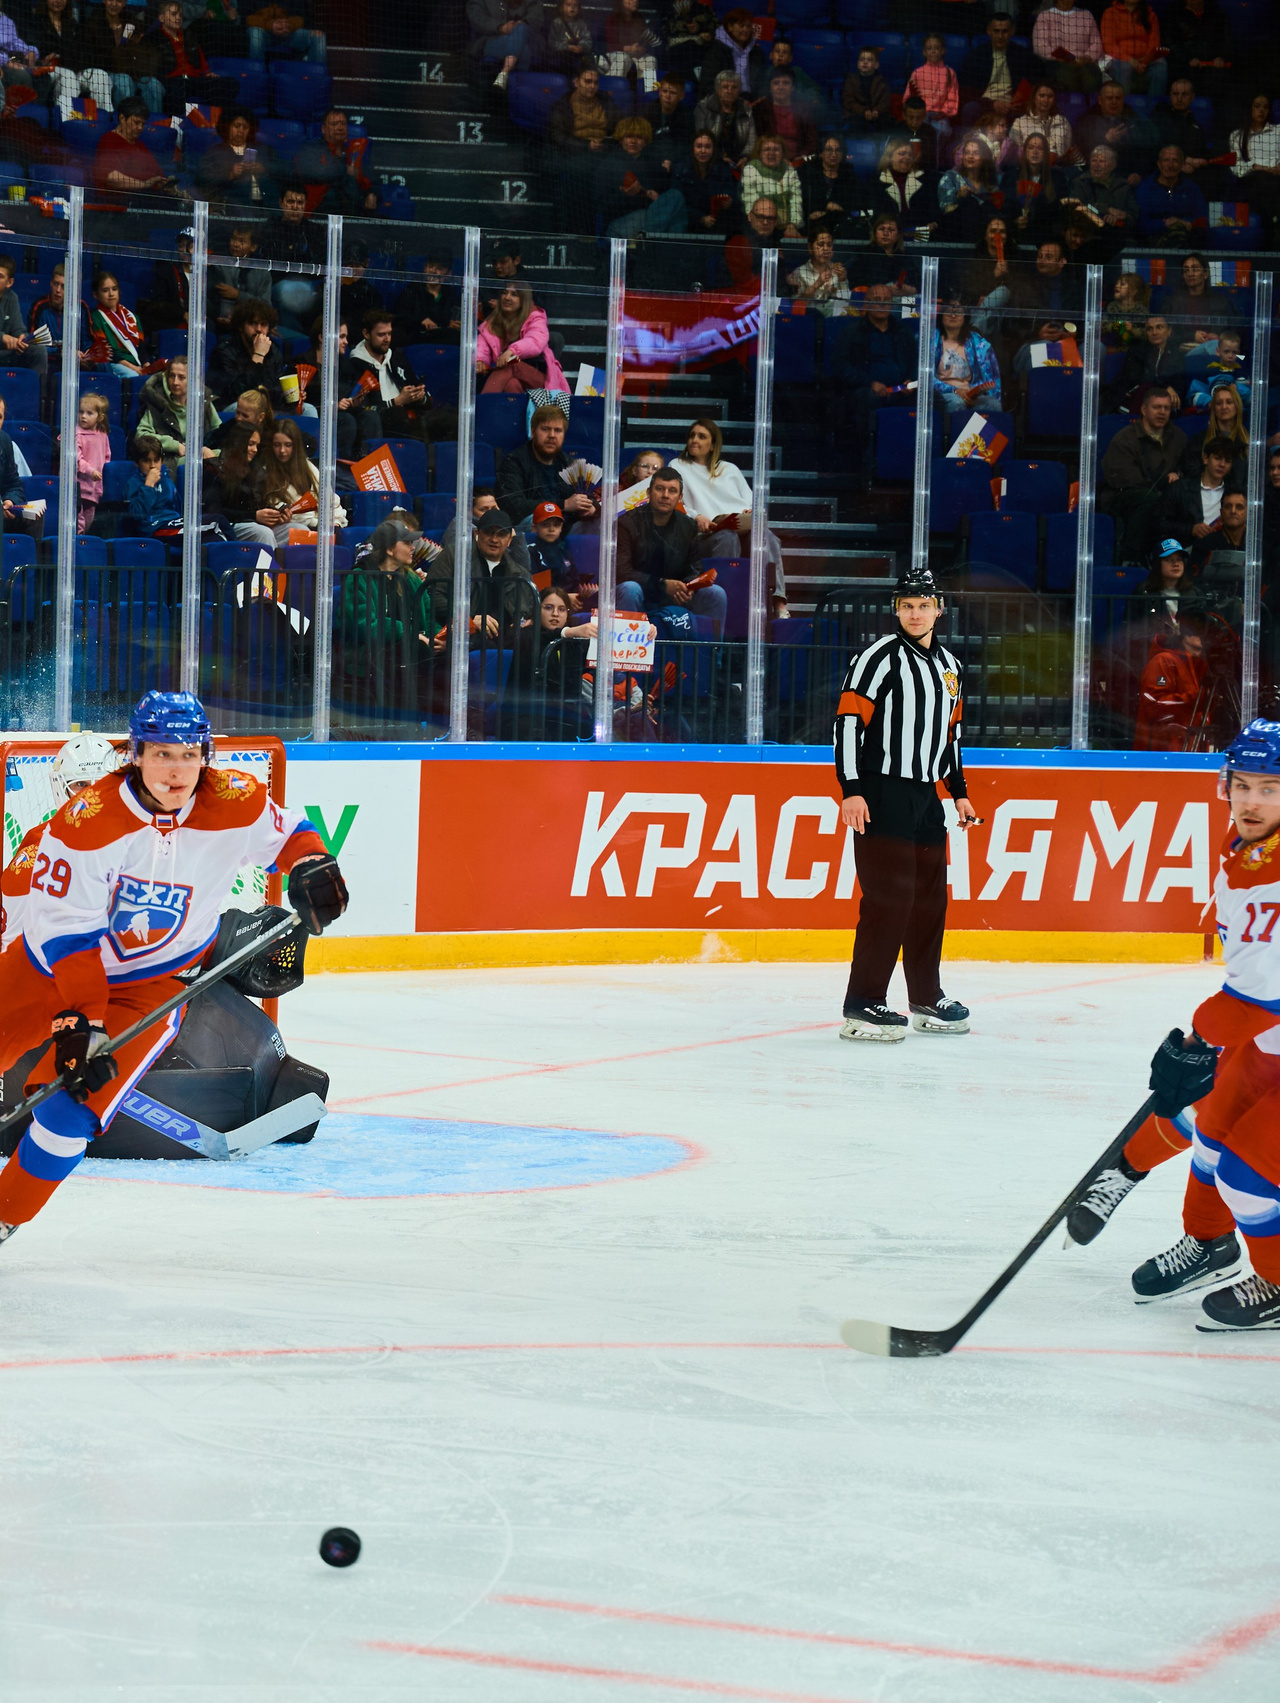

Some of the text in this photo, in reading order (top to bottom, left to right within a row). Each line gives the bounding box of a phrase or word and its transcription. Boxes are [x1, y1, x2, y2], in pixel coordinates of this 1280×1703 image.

[419, 62, 445, 84] 14
[456, 121, 484, 144] 13
[500, 180, 528, 203] 12
[546, 245, 568, 266] 11
[1241, 750, 1268, 758] CCM
[570, 791, 1212, 904] КРАСЯ МА
[31, 852, 72, 899] 29
[119, 876, 188, 911] СХЛ
[235, 919, 263, 936] BAUER
[1241, 902, 1280, 943] 17
[270, 1032, 286, 1061] BAUER
[123, 1094, 191, 1137] UER
